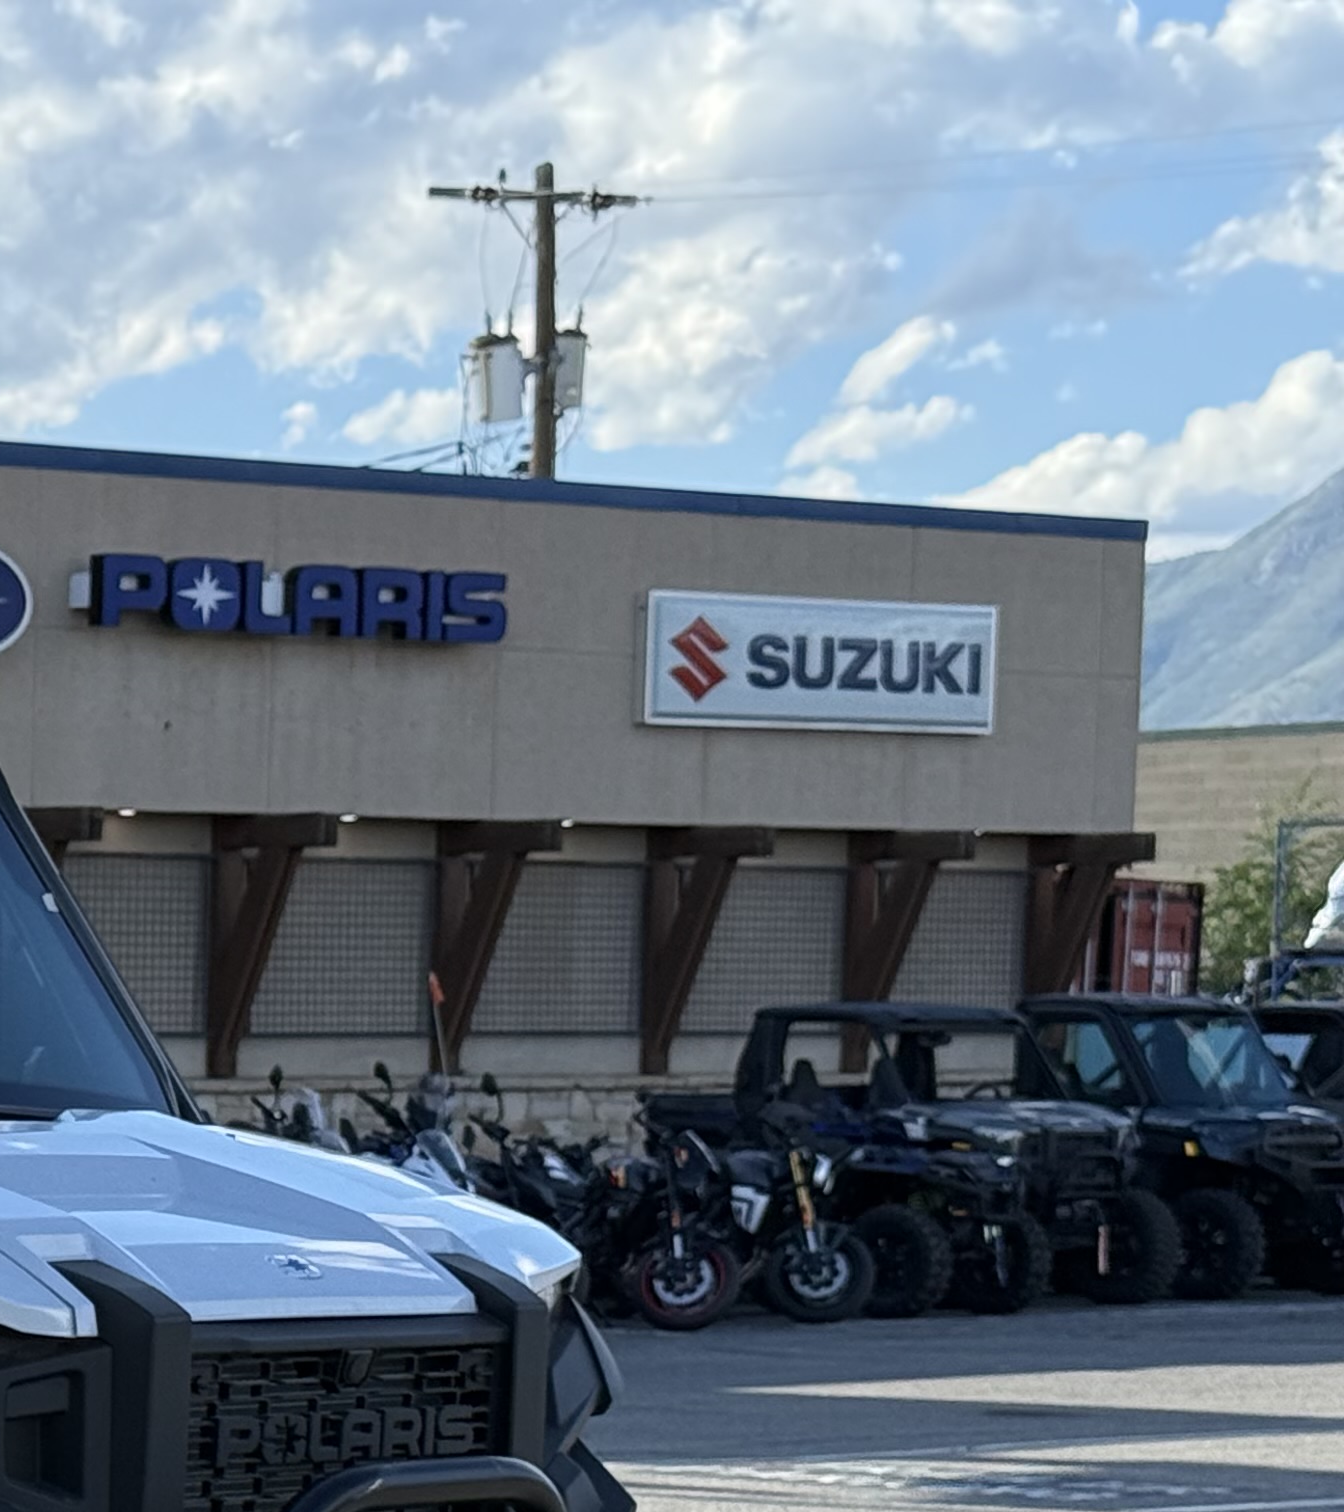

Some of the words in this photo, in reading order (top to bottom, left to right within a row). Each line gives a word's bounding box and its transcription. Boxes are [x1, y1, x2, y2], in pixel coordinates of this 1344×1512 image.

[90, 552, 508, 644] POLARIS
[745, 633, 983, 696] SUZUKI
[214, 1403, 475, 1469] POLARIS
